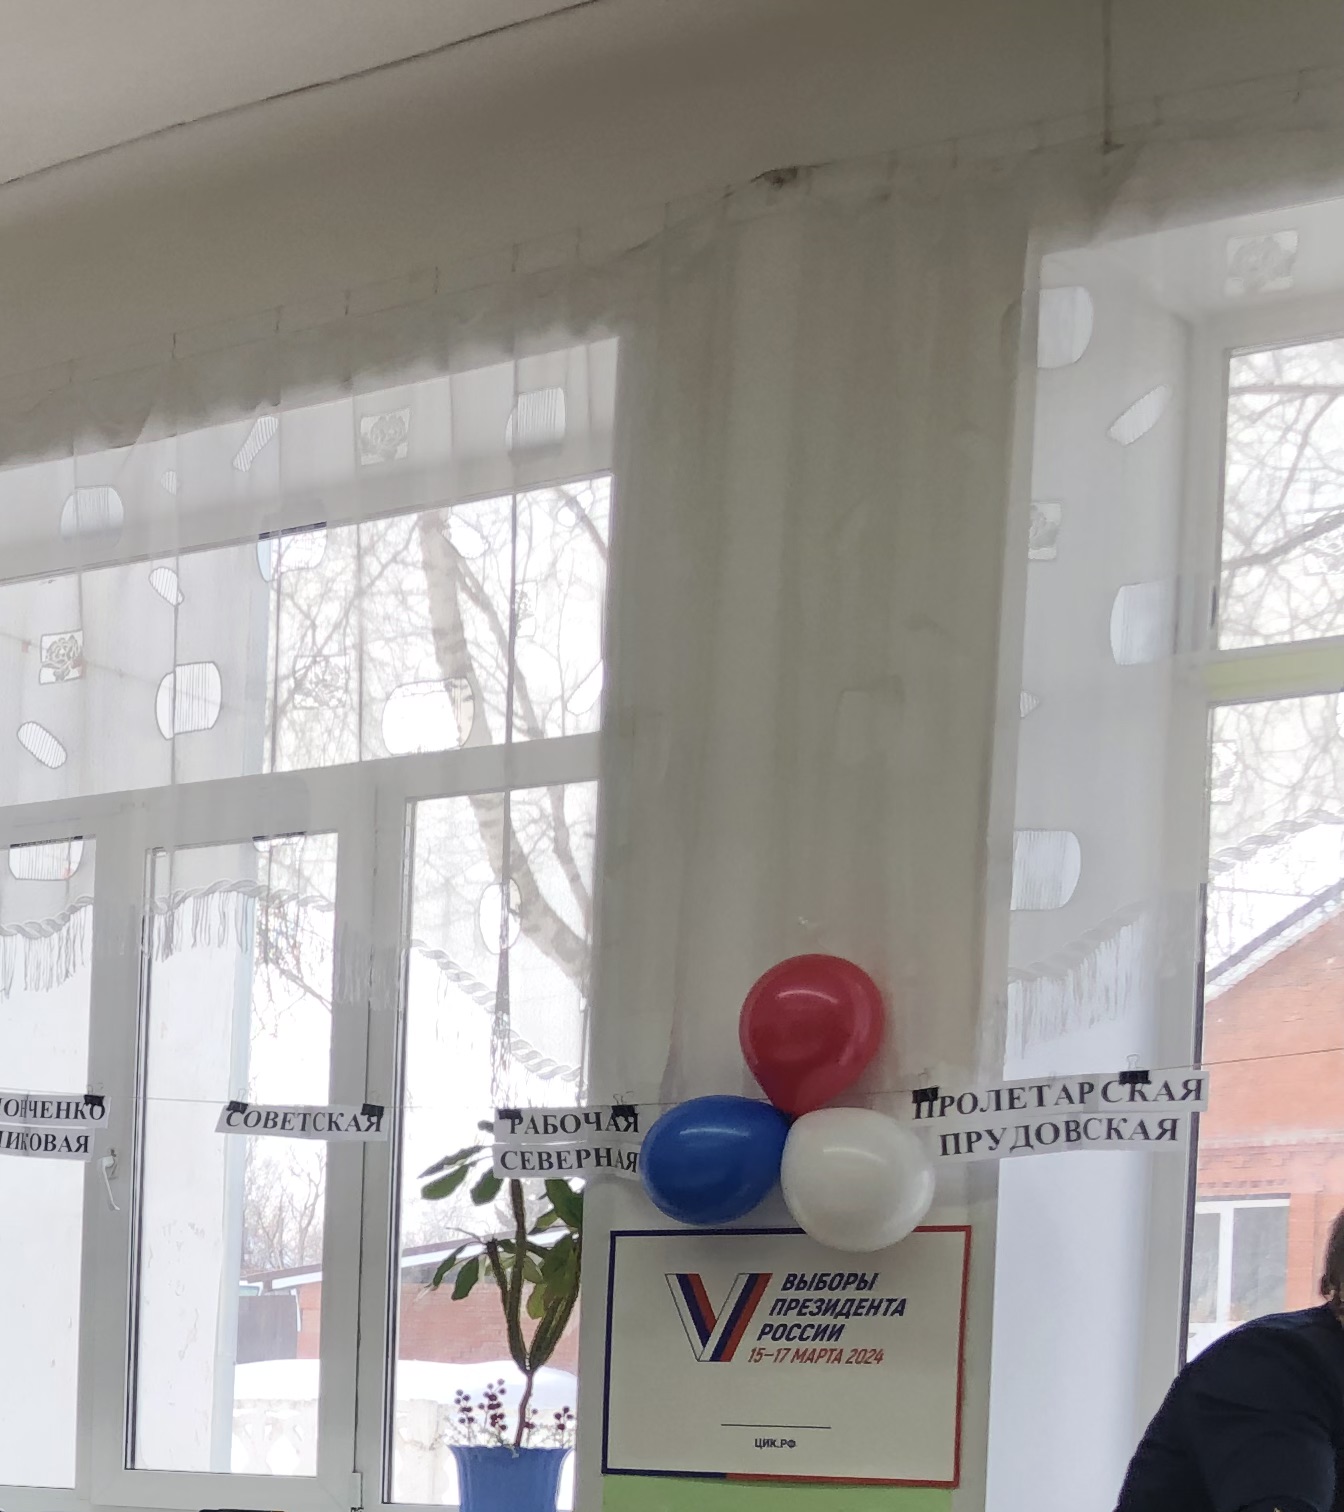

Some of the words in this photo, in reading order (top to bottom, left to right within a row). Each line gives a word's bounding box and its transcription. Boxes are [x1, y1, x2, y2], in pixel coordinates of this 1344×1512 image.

[912, 1078, 1205, 1120] ПРОЛЕТАРСКАЯ
[225, 1110, 383, 1133] СОВЕТСКАЯ
[508, 1110, 640, 1136] РАБОЧАЯ
[939, 1117, 1181, 1157] ПРУДОВСКАЯ
[500, 1147, 640, 1174] СЕВЕРНАЯ
[780, 1272, 880, 1292] ВЫБОРЫ
[768, 1298, 908, 1320] ПРЕЗИДЕНТА
[756, 1323, 847, 1342] РОССИИ
[790, 1348, 843, 1364] МАРТА
[844, 1348, 885, 1365] 2024
[754, 1438, 797, 1449] ЦИК.РФ
